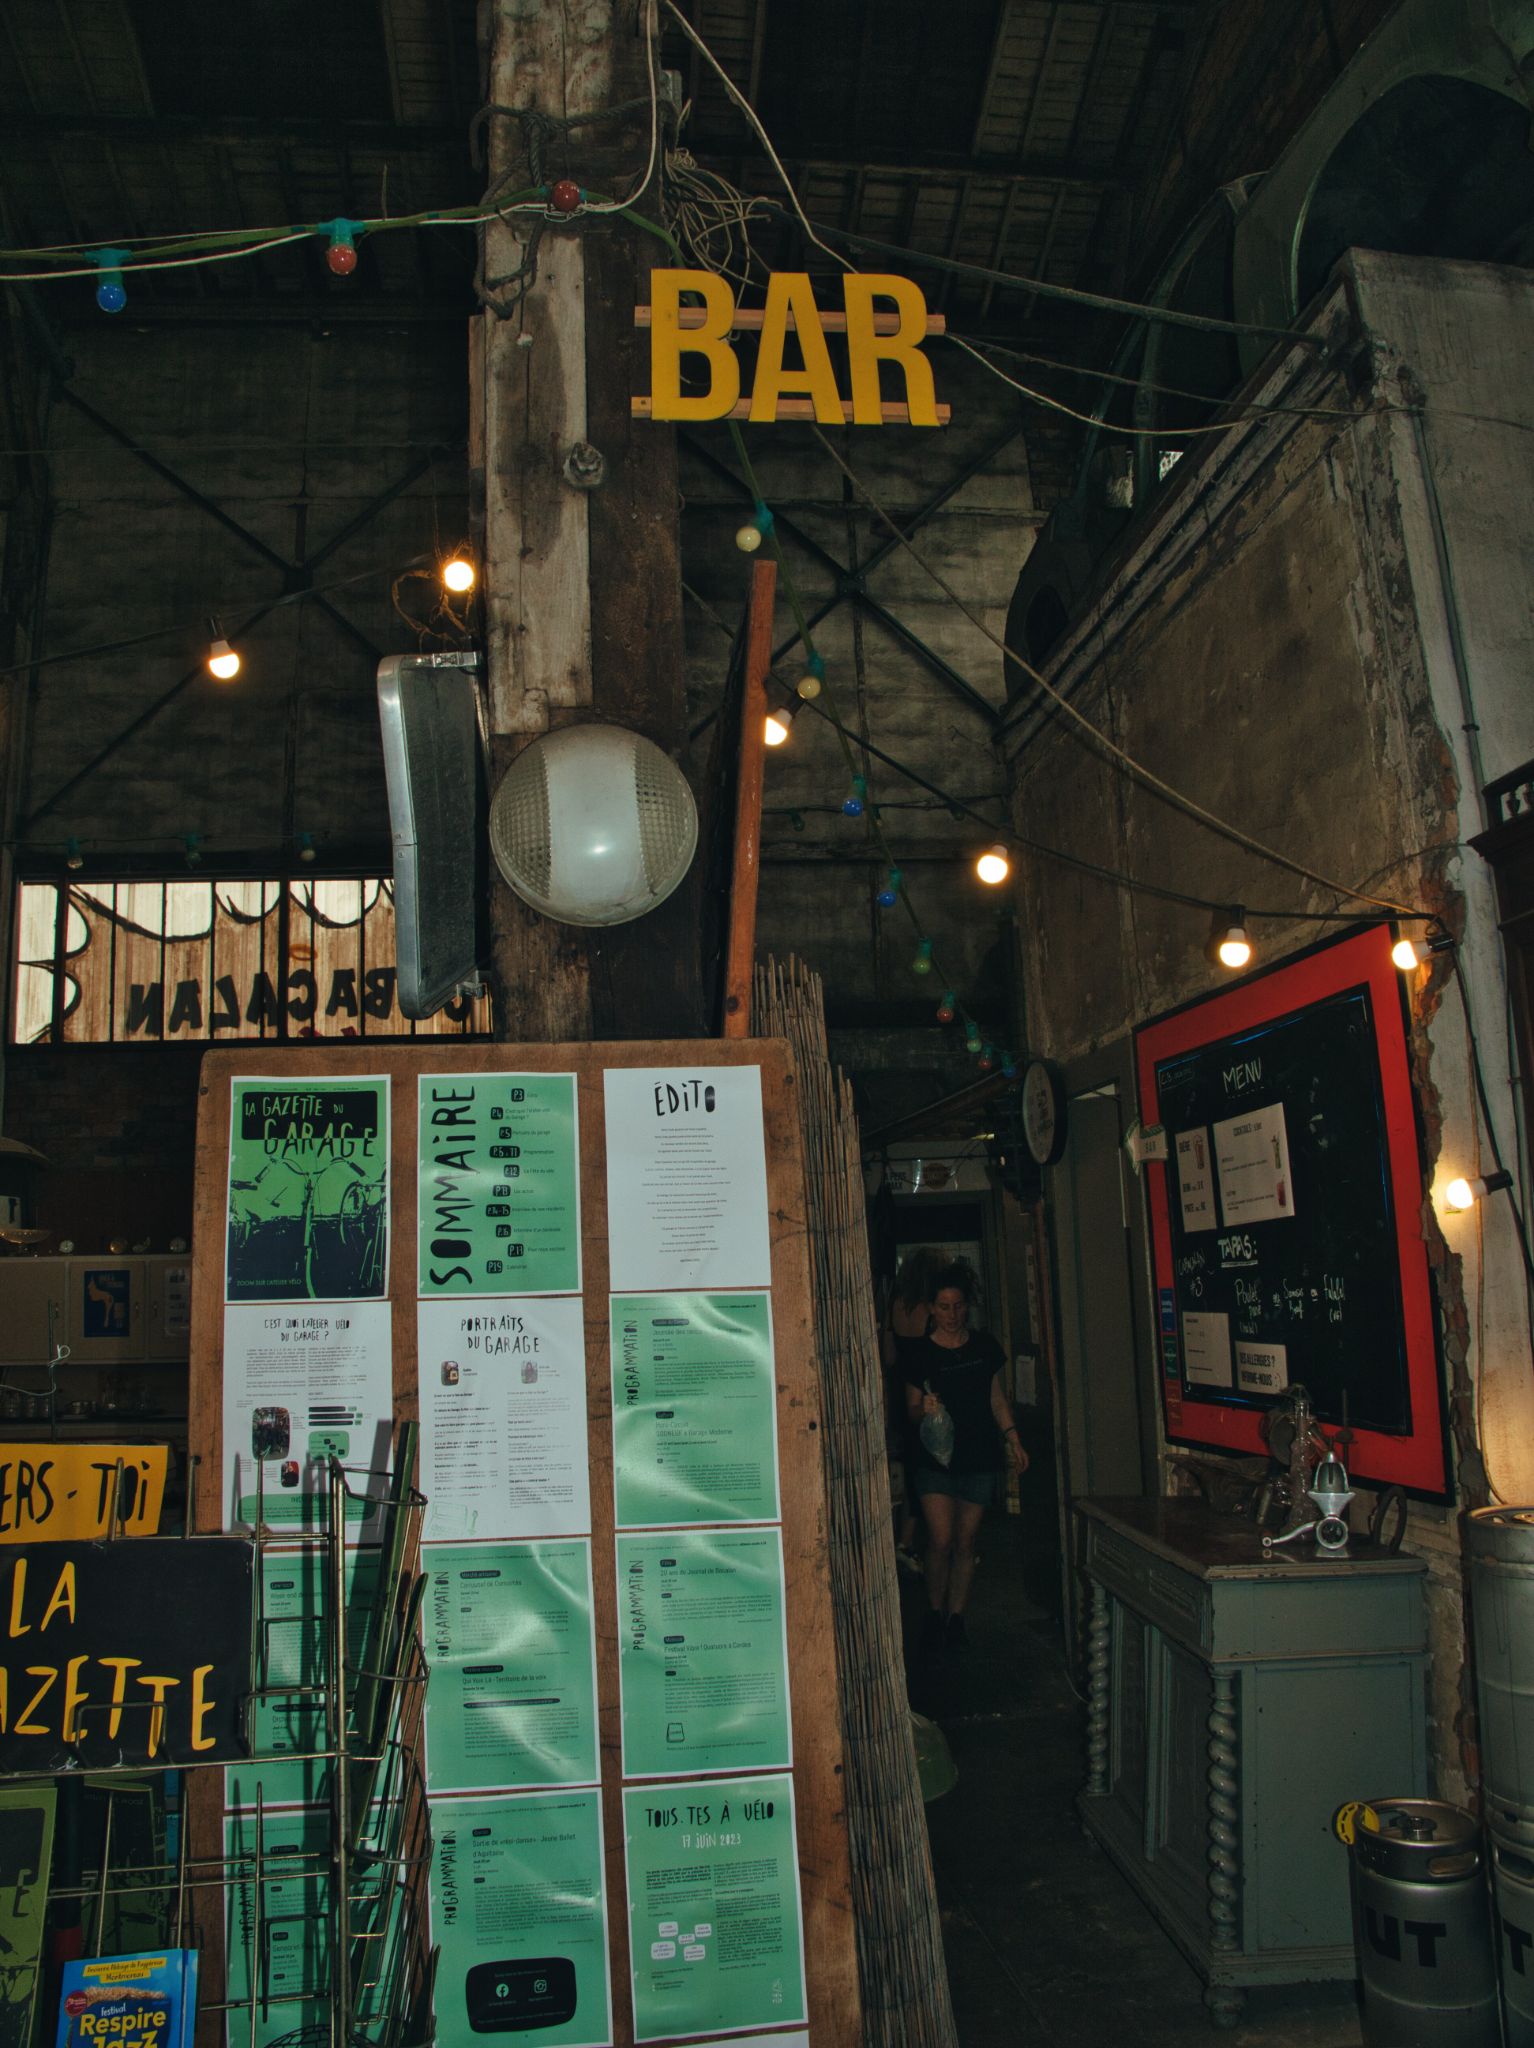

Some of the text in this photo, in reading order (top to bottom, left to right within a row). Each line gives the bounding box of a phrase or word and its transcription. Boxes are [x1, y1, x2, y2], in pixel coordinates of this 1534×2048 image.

[651, 269, 940, 426] BAR
[1222, 1057, 1263, 1094] MENU
[245, 1094, 344, 1120] LA GAZETTE DU
[264, 1118, 374, 1159] GARAGE
[281, 1330, 330, 1342] DU GARAGE ?
[468, 1335, 540, 1355] DU GARAGE
[9, 1557, 76, 1638] LA
[0, 1655, 217, 1758] ZETTE
[720, 1800, 731, 1825] À
[744, 1799, 774, 1822] VÉLO
[682, 1834, 691, 1848] 17
[720, 1832, 742, 1847] 2023
[80, 2007, 167, 2037] Respire
[101, 2003, 127, 2017] festival
